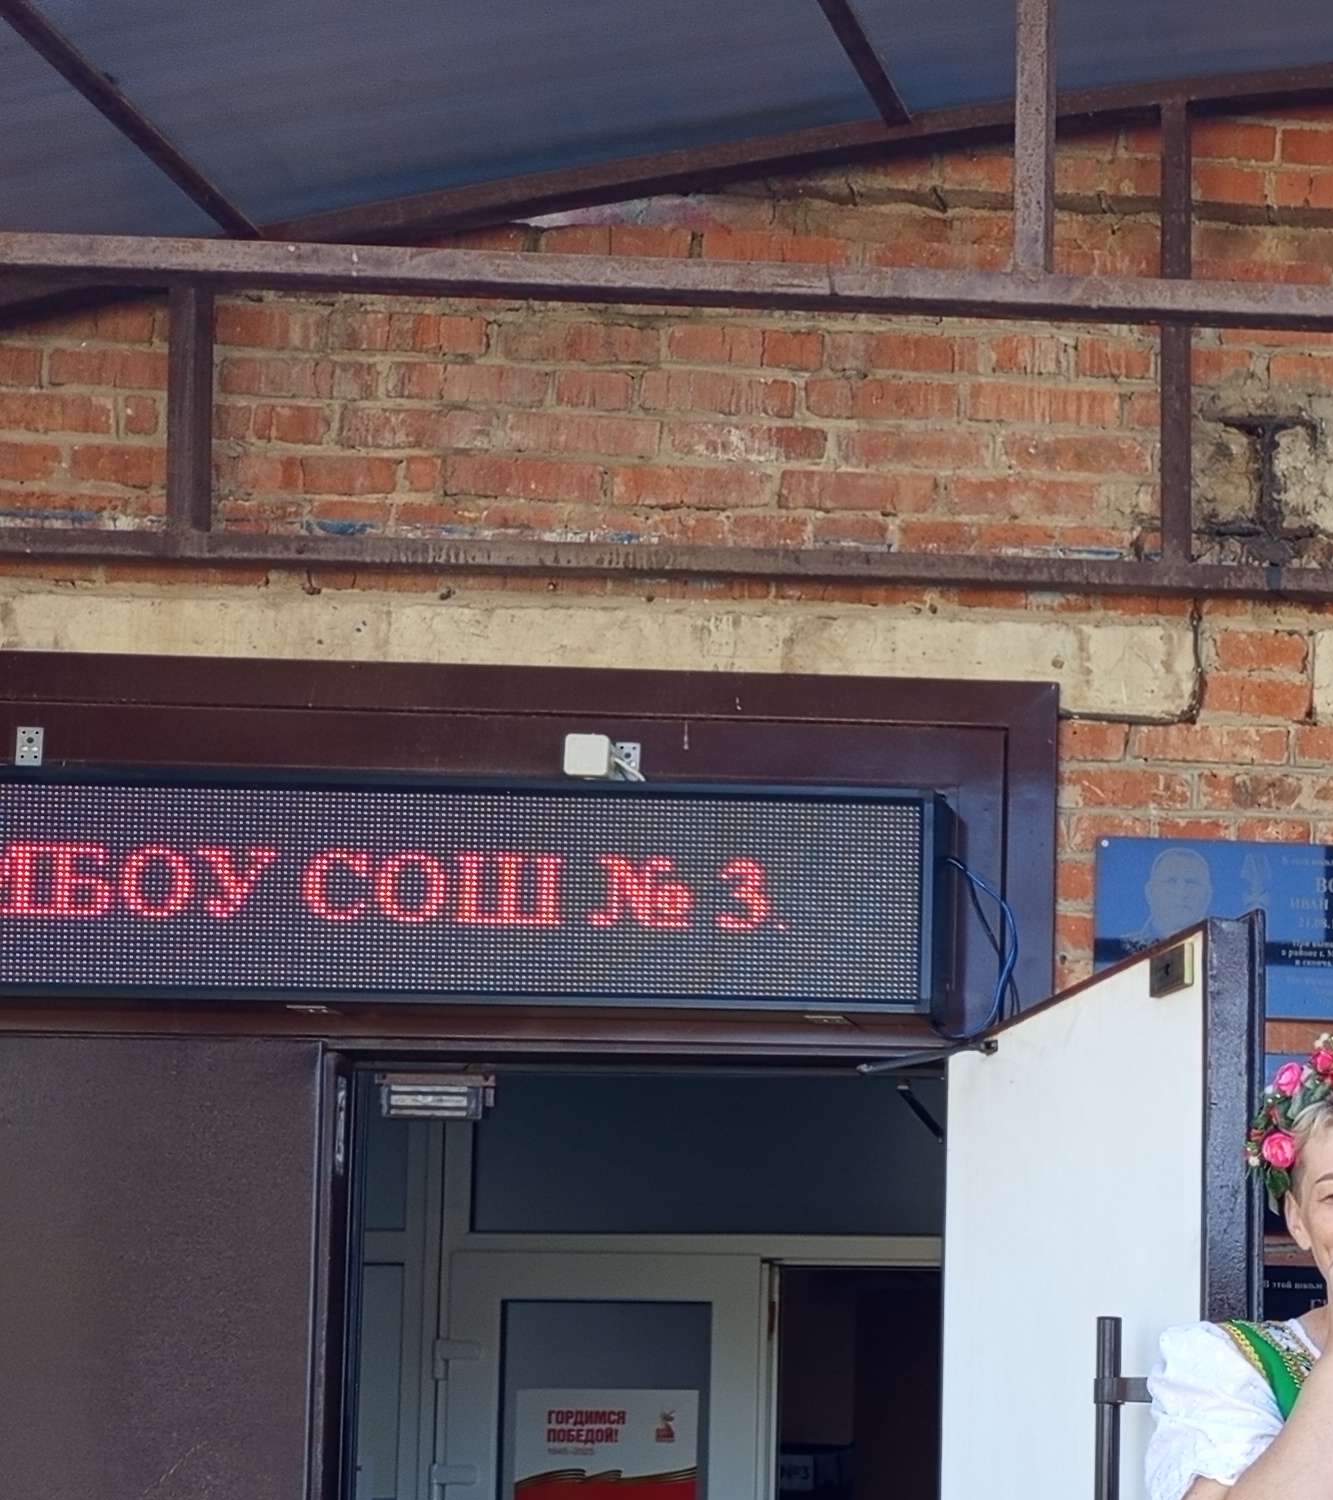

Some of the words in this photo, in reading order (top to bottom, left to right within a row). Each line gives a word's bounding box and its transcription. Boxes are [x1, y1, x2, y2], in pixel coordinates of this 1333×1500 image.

[303, 849, 564, 925] СОШ
[589, 855, 693, 928] №
[1290, 898, 1328, 910] ИВАН
[546, 1409, 627, 1427] ГОРДИМСЯ
[546, 1427, 620, 1445] ПОБЕДОЙ!
